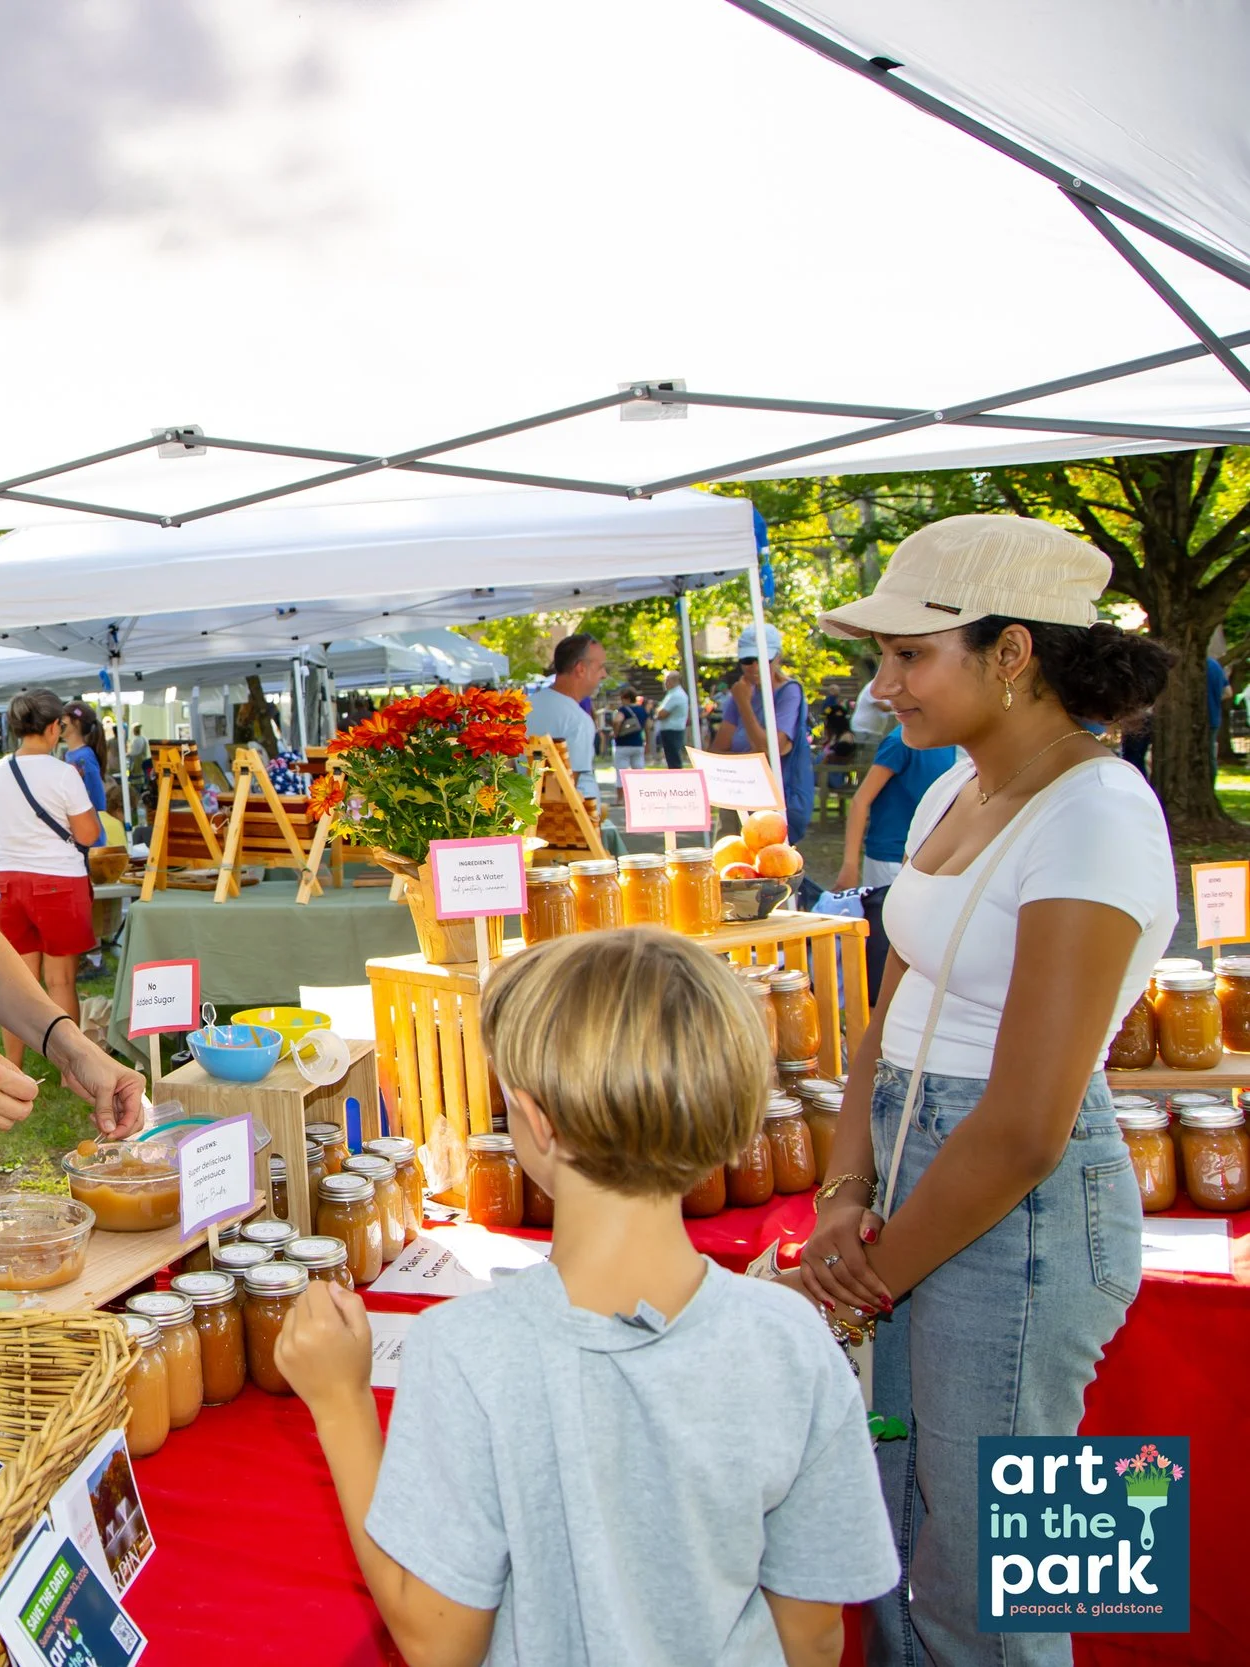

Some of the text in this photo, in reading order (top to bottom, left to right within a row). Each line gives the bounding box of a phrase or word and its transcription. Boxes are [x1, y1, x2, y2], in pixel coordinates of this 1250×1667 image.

[639, 788, 697, 799] Family Made!
[453, 875, 474, 883] Apples
[482, 873, 504, 881] Water
[148, 982, 157, 991] No
[154, 995, 175, 1005] Sugar
[196, 1140, 217, 1154] REVIEWS:
[399, 1247, 431, 1273] Plain or
[26, 1563, 70, 1632] SAVE THE DATE!
[50, 1630, 72, 1667] art
